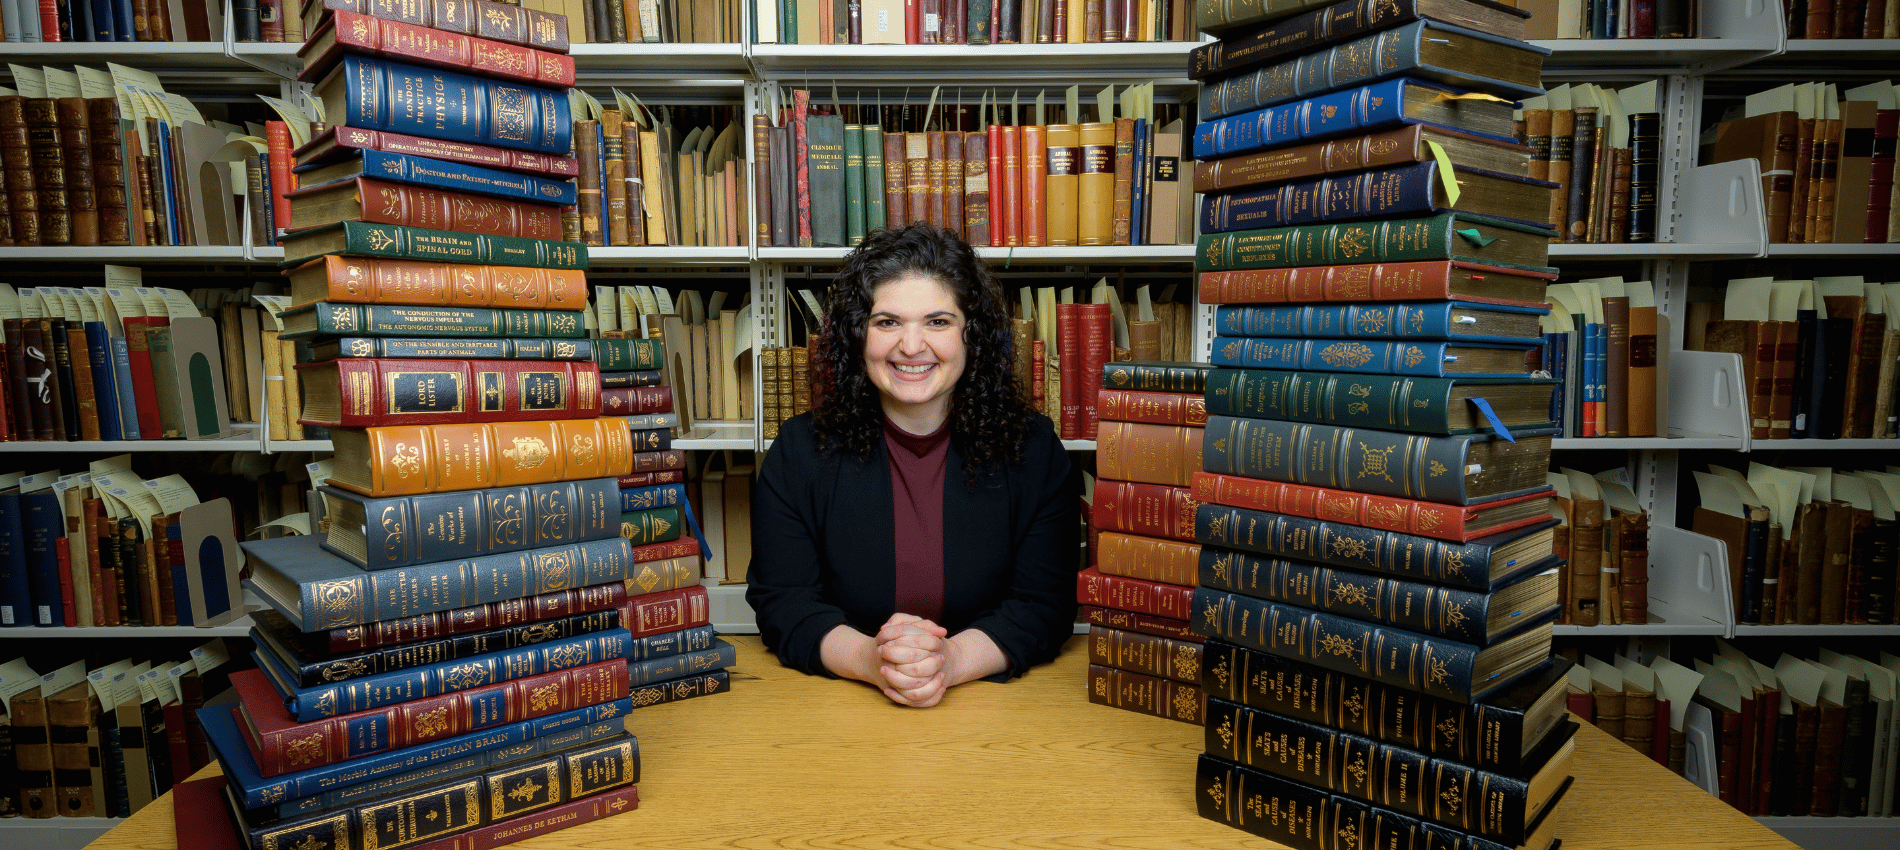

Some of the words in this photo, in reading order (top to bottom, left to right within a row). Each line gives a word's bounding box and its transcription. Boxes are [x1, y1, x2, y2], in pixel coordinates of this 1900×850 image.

[1228, 42, 1269, 59] CONVULSIONS
[1280, 31, 1308, 45] INFANTS
[405, 77, 413, 118] LONDON
[415, 77, 424, 124] PRACTICE
[433, 75, 445, 130] PHYSICK
[388, 143, 419, 152] OPERATIVE
[420, 146, 444, 154] SURGERY
[417, 140, 437, 148] LINEAR
[438, 143, 474, 152] CRANIOTOMY
[415, 166, 446, 178] DOCTOR
[462, 173, 490, 185] PATIENT
[494, 180, 525, 190] MITCHELL
[1382, 172, 1388, 180] OF
[1387, 173, 1395, 206] MEDICINE
[1394, 174, 1402, 202] LIBRARY
[1230, 194, 1277, 206] PSYCHOPATHIA
[1379, 180, 1387, 210] CLASSICS
[1236, 211, 1267, 221] SEXUALIS
[416, 245, 448, 254] SPINAL
[449, 247, 472, 256] CORD
[430, 236, 458, 245] BRAIN
[1236, 243, 1280, 253] CONDITIONED
[1238, 235, 1272, 244] LECTURES
[1241, 253, 1275, 262] REFLEXES
[386, 274, 392, 284] On
[418, 380, 426, 405] LORD
[428, 378, 436, 407] LISTER
[1257, 376, 1267, 413] Surgeon's
[1270, 381, 1279, 409] Journal
[1303, 381, 1311, 412] CUSHING
[1265, 432, 1274, 468] NERVOUS
[1274, 436, 1282, 466] SYSTEM
[447, 511, 454, 519] of
[457, 506, 466, 544] Hippocrates
[427, 522, 435, 536] The
[1248, 518, 1257, 545] Neurology
[1251, 561, 1259, 589] Neurology
[398, 571, 408, 617] COLLECTED
[422, 588, 428, 597] OF
[431, 575, 439, 606] JOSEPH
[1241, 609, 1250, 636] Neurology
[650, 637, 674, 646] CHARLES
[1260, 670, 1268, 694] SEATS
[1276, 671, 1284, 701] CAUSES
[1294, 674, 1302, 709] DISEASES
[551, 734, 580, 745] GODDARD
[1290, 747, 1296, 756] of
[319, 776, 336, 787] The
[338, 768, 367, 784] Morbid
[369, 760, 404, 779] Anatomy
[405, 755, 414, 766] of
[415, 752, 428, 764] the
[430, 742, 472, 760] HUMAN
[475, 733, 509, 750] BRAIN
[1401, 763, 1408, 771] II
[408, 801, 417, 839] CHIRURGIA
[1271, 797, 1279, 826] CAUSES
[387, 821, 393, 832] DE
[493, 824, 533, 840] JOHANNES
[547, 812, 577, 826] KETHAM
